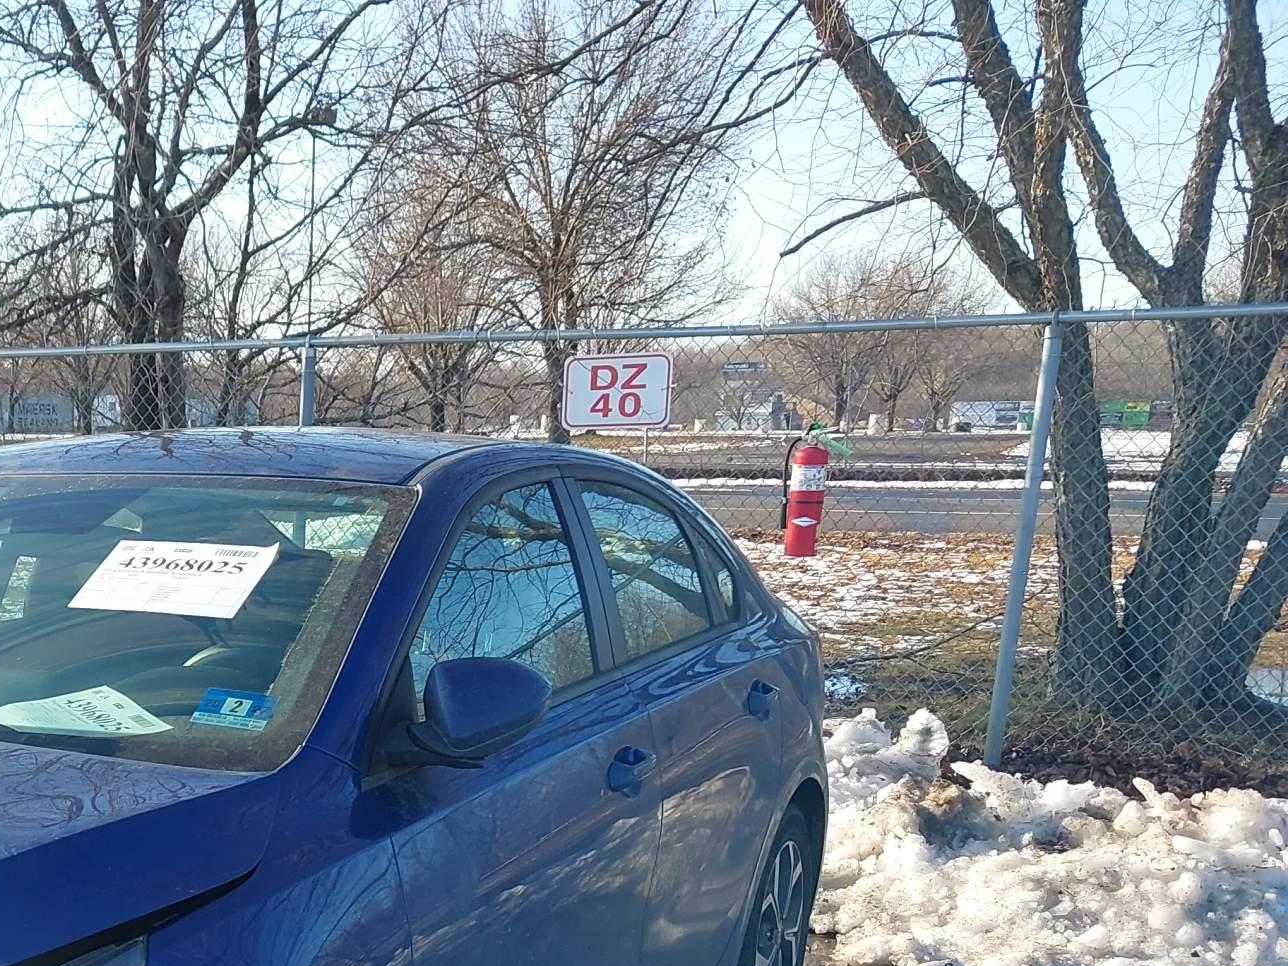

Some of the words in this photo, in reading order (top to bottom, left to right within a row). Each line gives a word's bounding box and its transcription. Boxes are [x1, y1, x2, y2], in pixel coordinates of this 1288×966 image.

[590, 363, 648, 391] DZ
[590, 392, 642, 418] 40
[119, 556, 249, 575] 43968025
[63, 698, 132, 732] 43968025
[228, 700, 244, 713] 2
